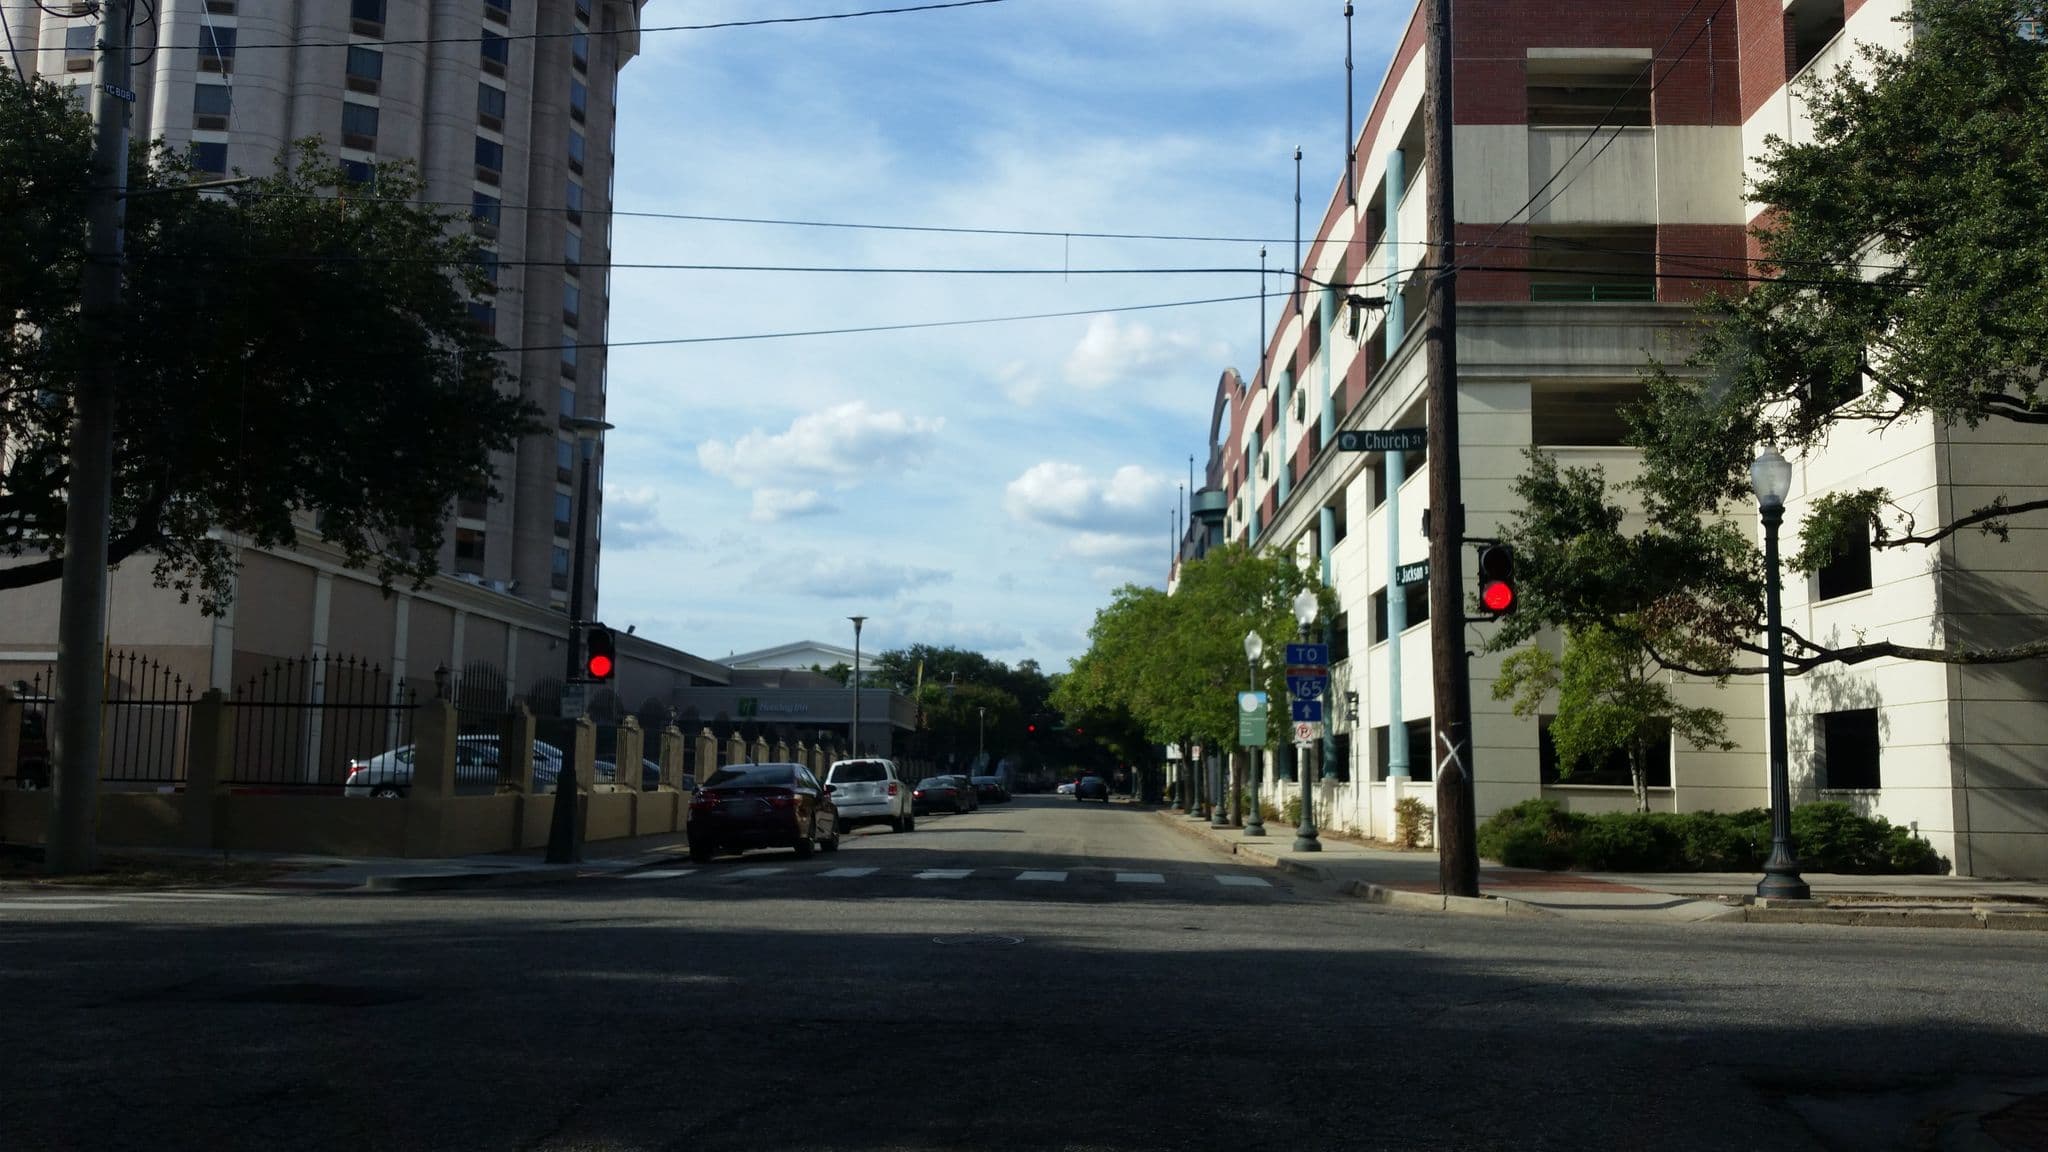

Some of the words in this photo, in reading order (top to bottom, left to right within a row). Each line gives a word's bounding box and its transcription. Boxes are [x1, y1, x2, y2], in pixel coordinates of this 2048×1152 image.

[1365, 433, 1409, 449] Church
[1402, 566, 1423, 583] Jackson
[1296, 648, 1317, 661] TO
[1295, 681, 1321, 698] 165
